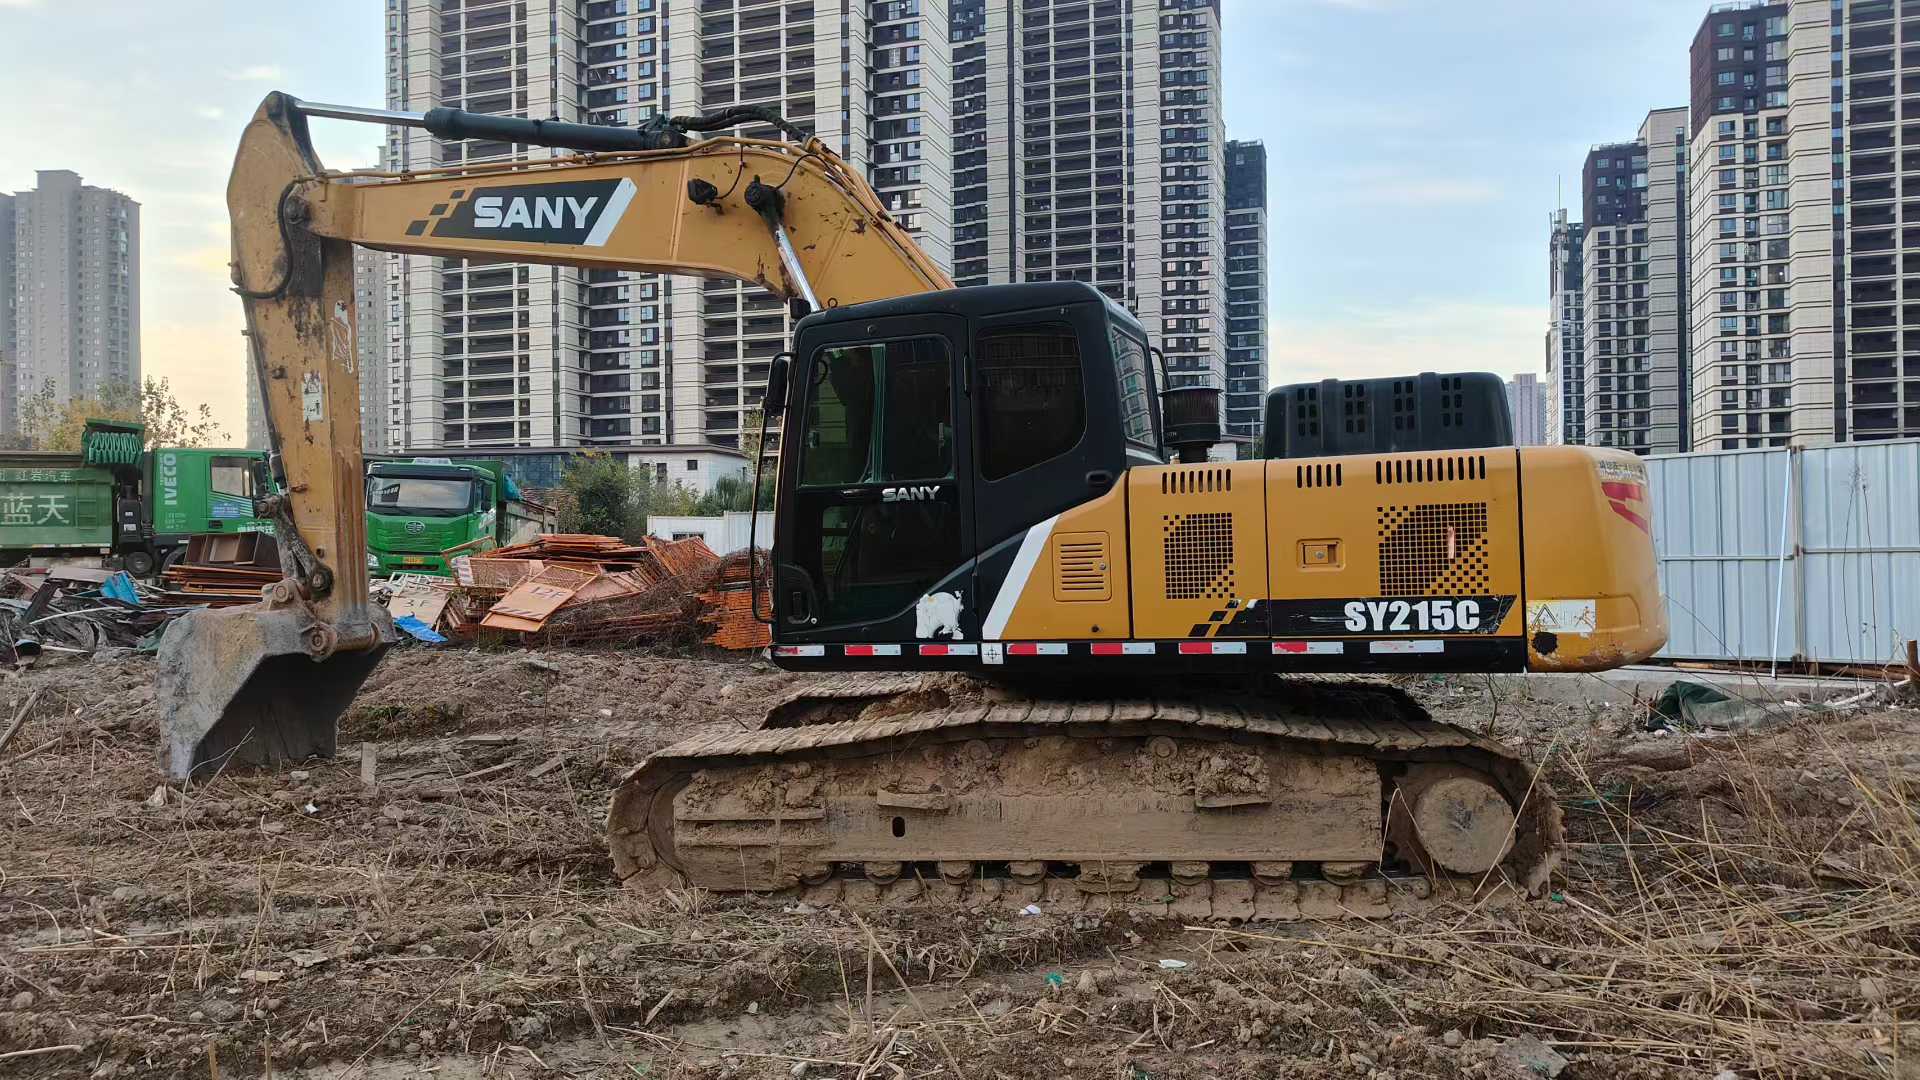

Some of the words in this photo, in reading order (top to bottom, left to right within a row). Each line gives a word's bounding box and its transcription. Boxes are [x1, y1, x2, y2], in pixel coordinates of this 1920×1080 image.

[473, 196, 599, 229] SANY
[163, 453, 177, 505] IVECO
[881, 485, 941, 502] SANY
[0, 492, 70, 525] 蓝天
[1344, 600, 1480, 632] SY215C
